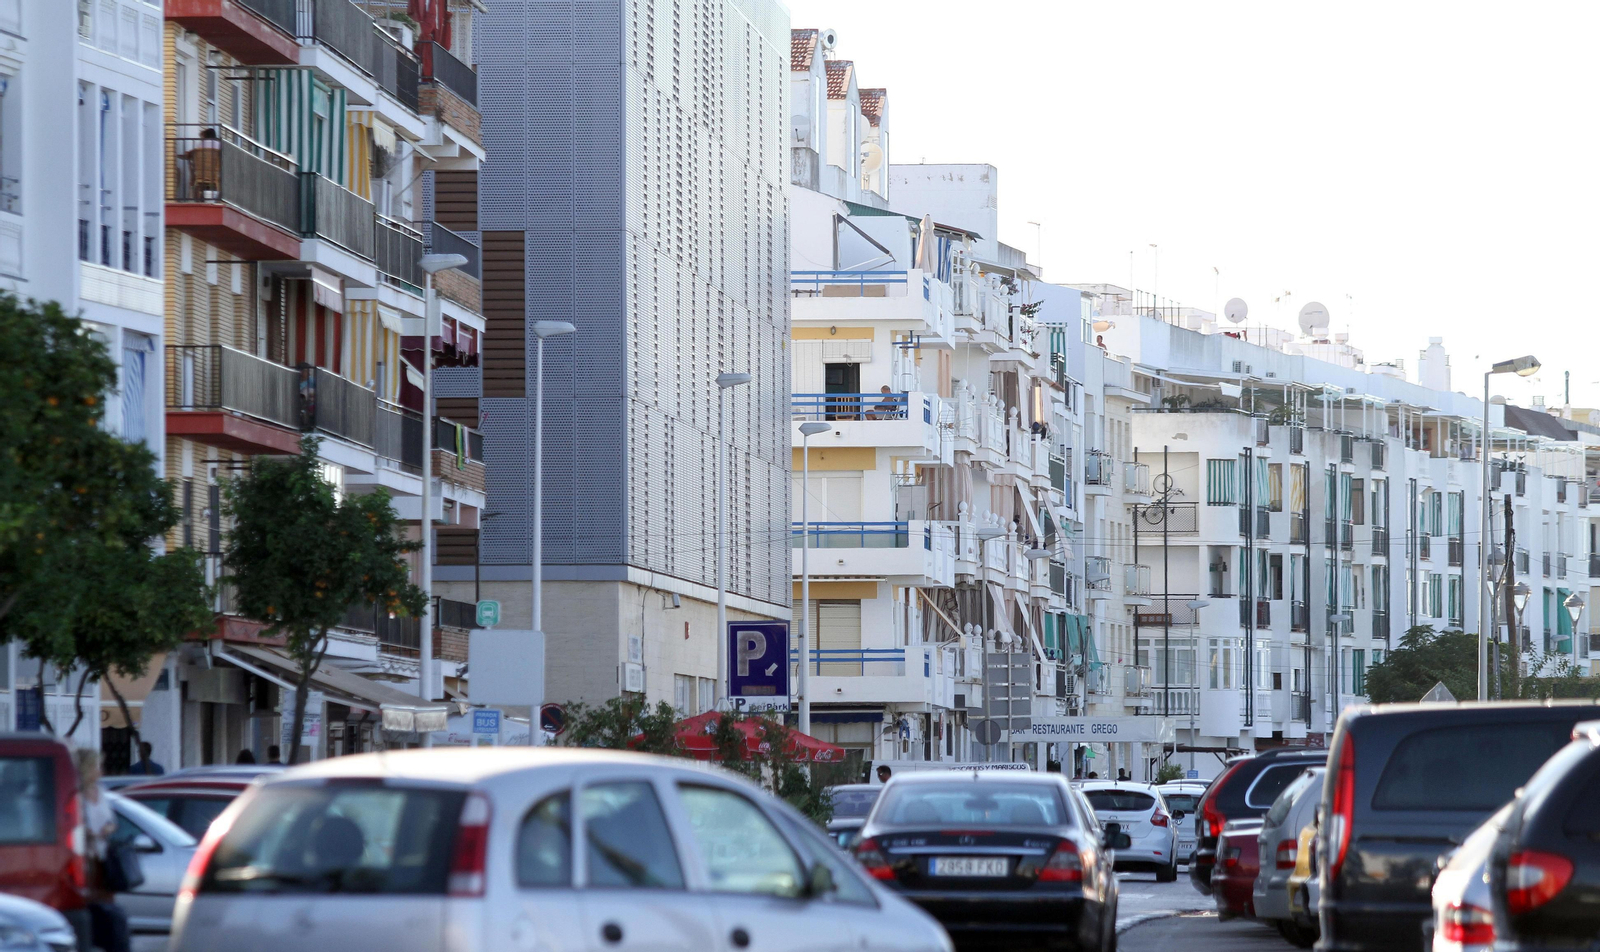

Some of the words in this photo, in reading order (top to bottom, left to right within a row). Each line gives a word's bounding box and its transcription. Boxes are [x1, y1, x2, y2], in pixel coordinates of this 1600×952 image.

[737, 630, 767, 677] P
[476, 718, 496, 727] BUS
[1032, 724, 1085, 735] RESTAURANTE
[1091, 723, 1118, 735] GREGO
[991, 763, 1026, 771] MARISCOS
